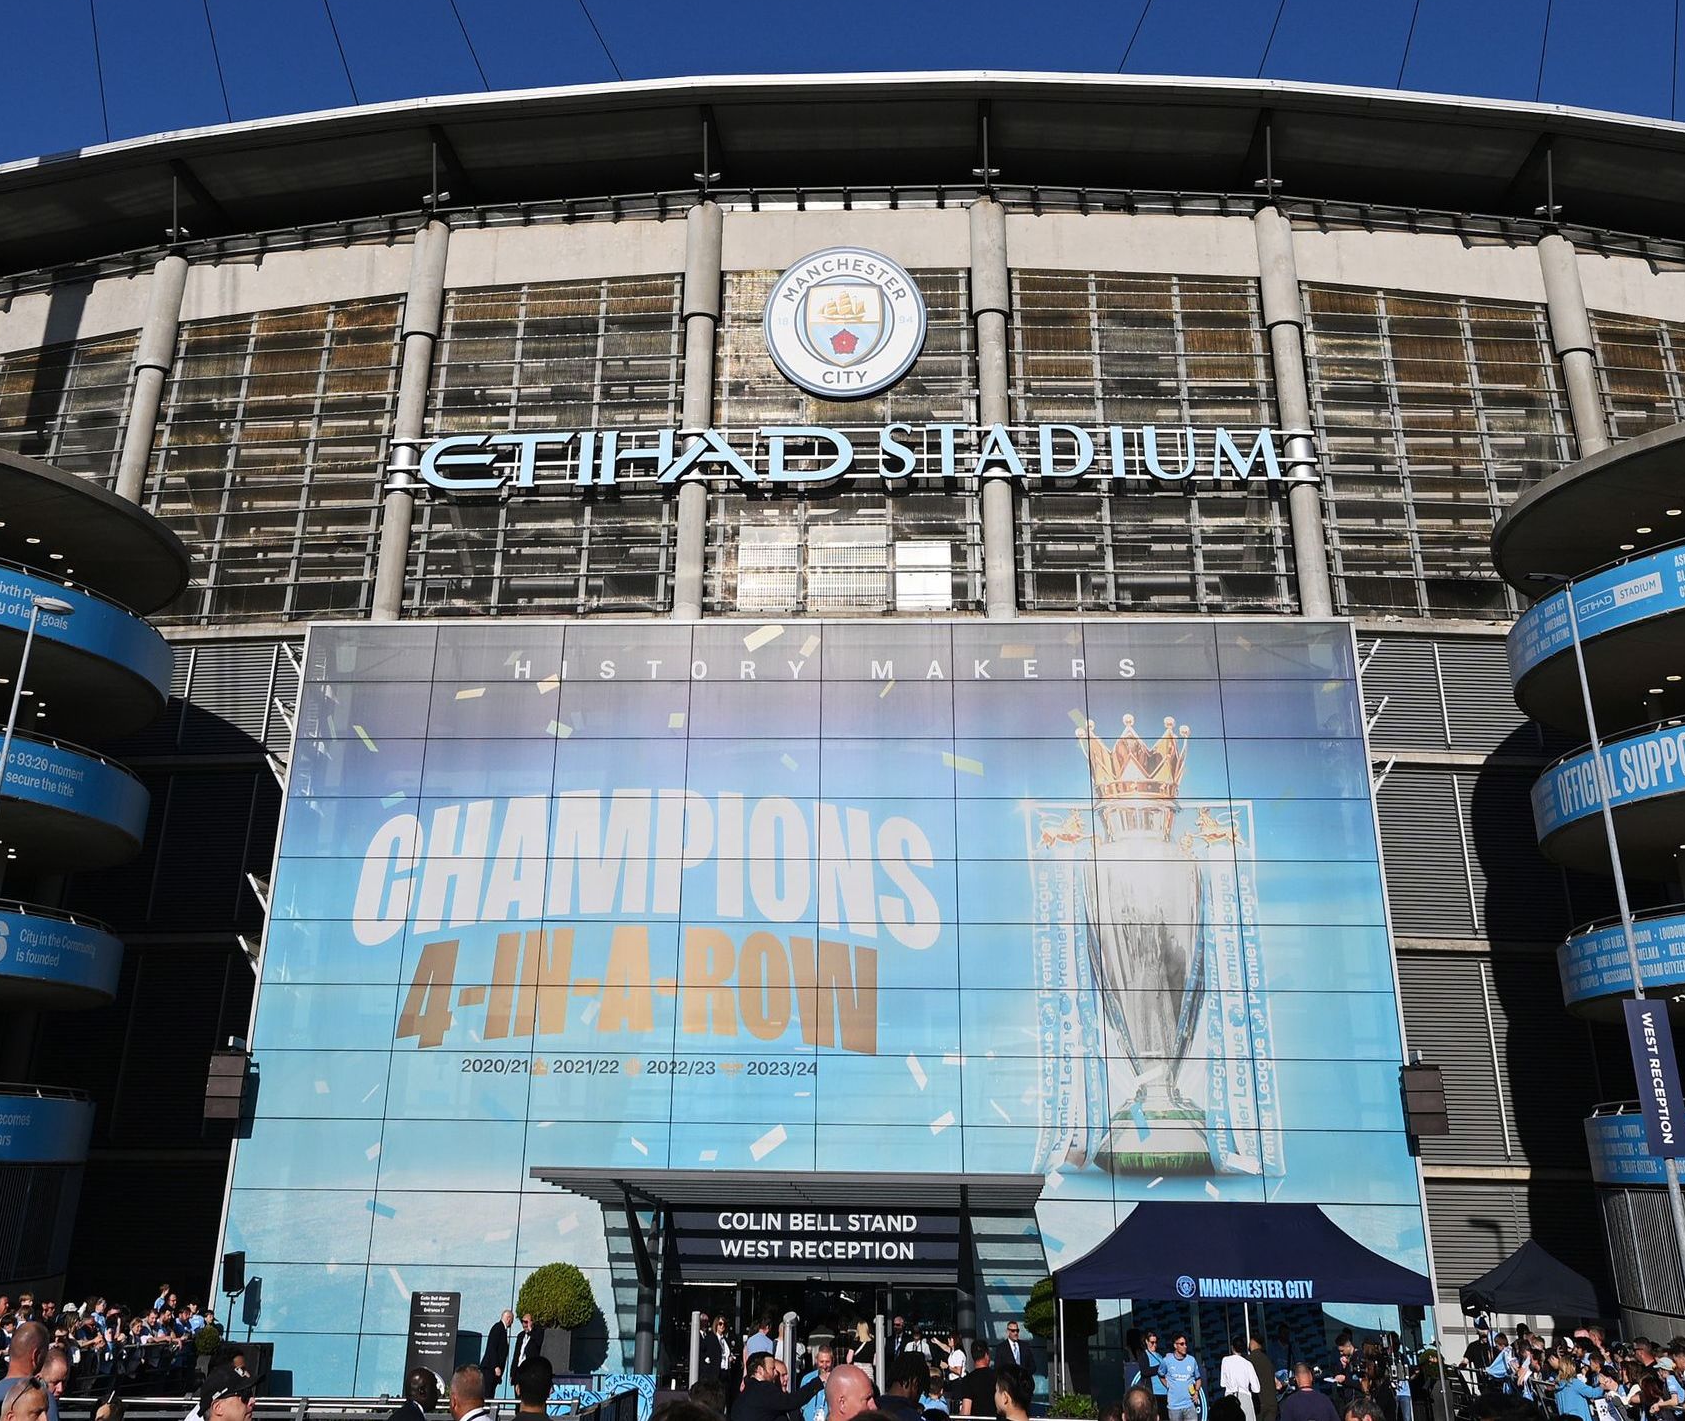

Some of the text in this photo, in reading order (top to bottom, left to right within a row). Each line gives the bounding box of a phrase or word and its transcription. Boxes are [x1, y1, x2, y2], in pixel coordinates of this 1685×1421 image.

[781, 257, 909, 304] MANCHESTER
[822, 370, 869, 386] CITY
[419, 422, 1283, 489] ETIHAD STADIUM
[1579, 580, 1656, 614] ETIHAD STADIUM
[8, 604, 20, 615] of
[41, 614, 67, 630] goals
[515, 658, 1138, 681] HISTORY MAKERS
[352, 788, 943, 951] CHAMPIONS
[395, 925, 878, 1056] 4-IN-A-ROW
[461, 1058, 819, 1078] 2020/21 2021/22 2022/23 2023/24
[1641, 1012, 1674, 1145] WEST RECEPTION
[718, 1212, 917, 1233] COLIN BELL STAND
[720, 1240, 914, 1260] WEST RECEPTION
[1199, 1278, 1313, 1299] MANCHESTER CITY
